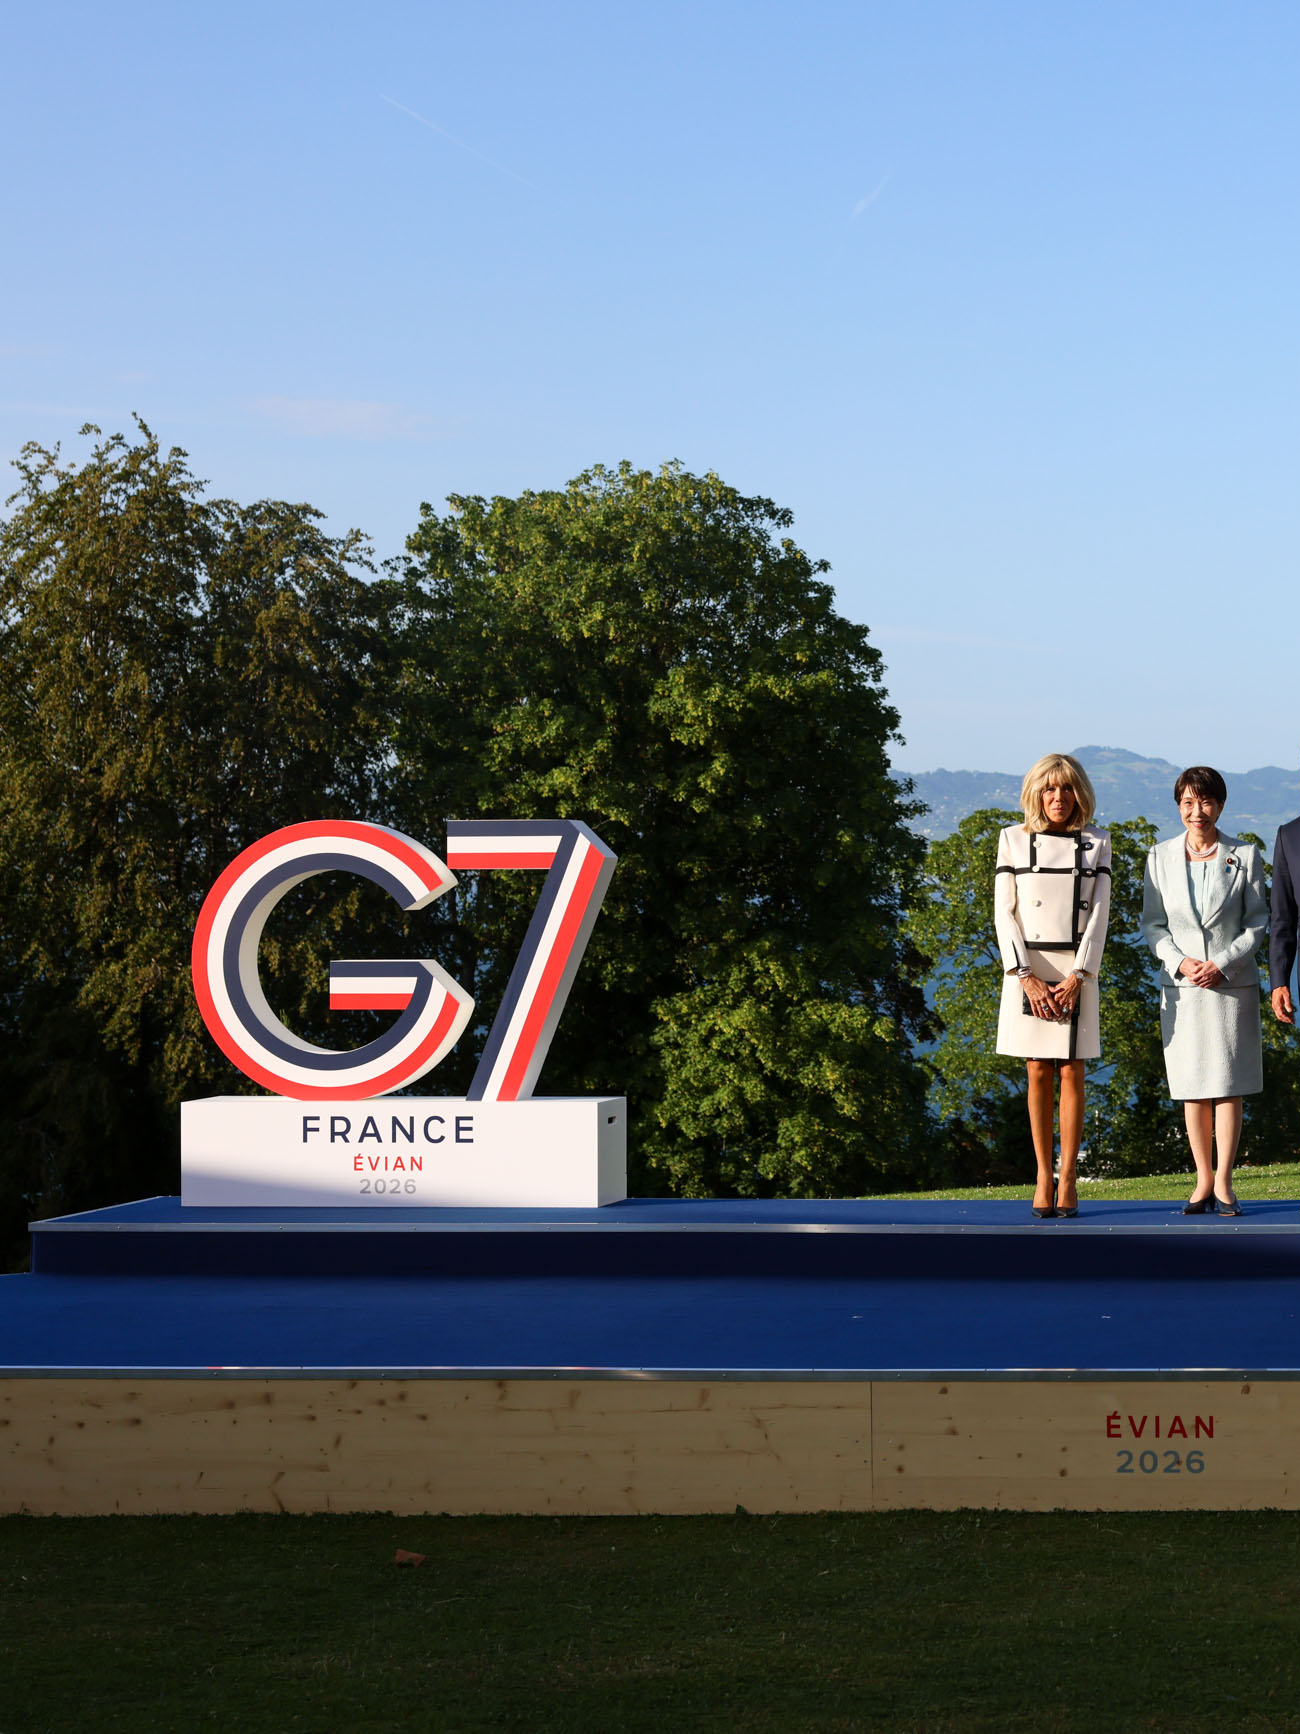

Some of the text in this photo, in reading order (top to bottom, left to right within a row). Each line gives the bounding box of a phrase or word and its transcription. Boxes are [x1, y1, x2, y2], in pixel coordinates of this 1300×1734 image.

[191, 819, 618, 1101] G7
[301, 1115, 475, 1144] FRANCE
[353, 1153, 423, 1171] ÉVIAN
[359, 1178, 417, 1194] 2026
[1106, 1410, 1215, 1438] ÉVIAN
[1116, 1450, 1205, 1474] 2026
